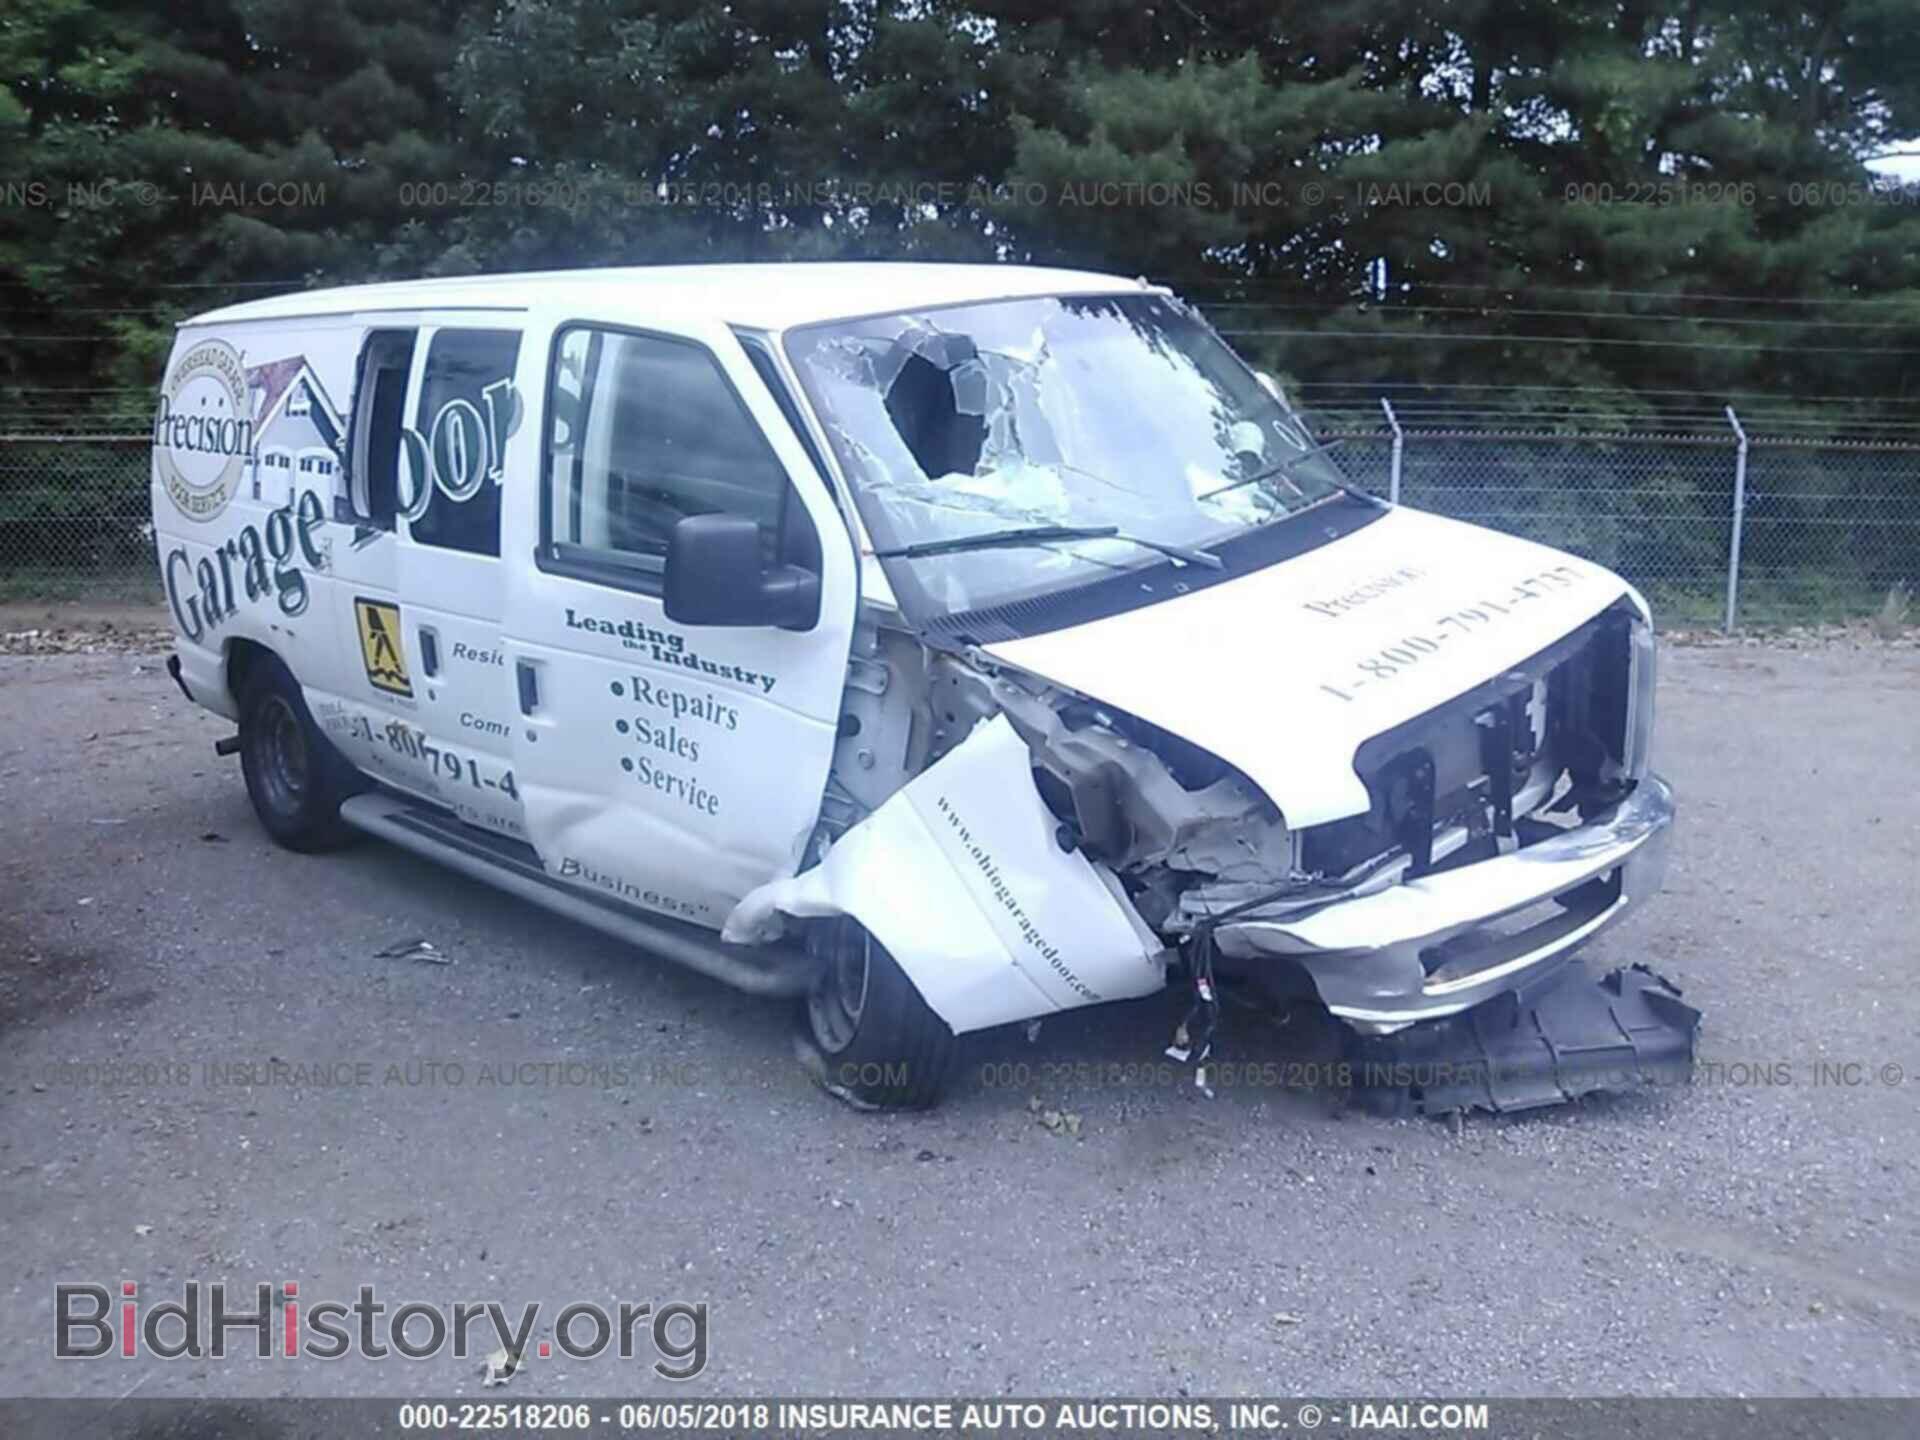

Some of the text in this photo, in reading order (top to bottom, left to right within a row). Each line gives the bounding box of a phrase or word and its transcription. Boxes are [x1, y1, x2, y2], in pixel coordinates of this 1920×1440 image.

[153, 393, 253, 457] Precision
[166, 489, 326, 645] Garage
[565, 608, 685, 653] Leading
[622, 638, 648, 652] the
[1320, 565, 1586, 702] 1-800-791-4737
[652, 643, 777, 693] Industry
[631, 675, 740, 732] Repairs
[634, 716, 700, 763] Sales
[637, 755, 720, 817] Service
